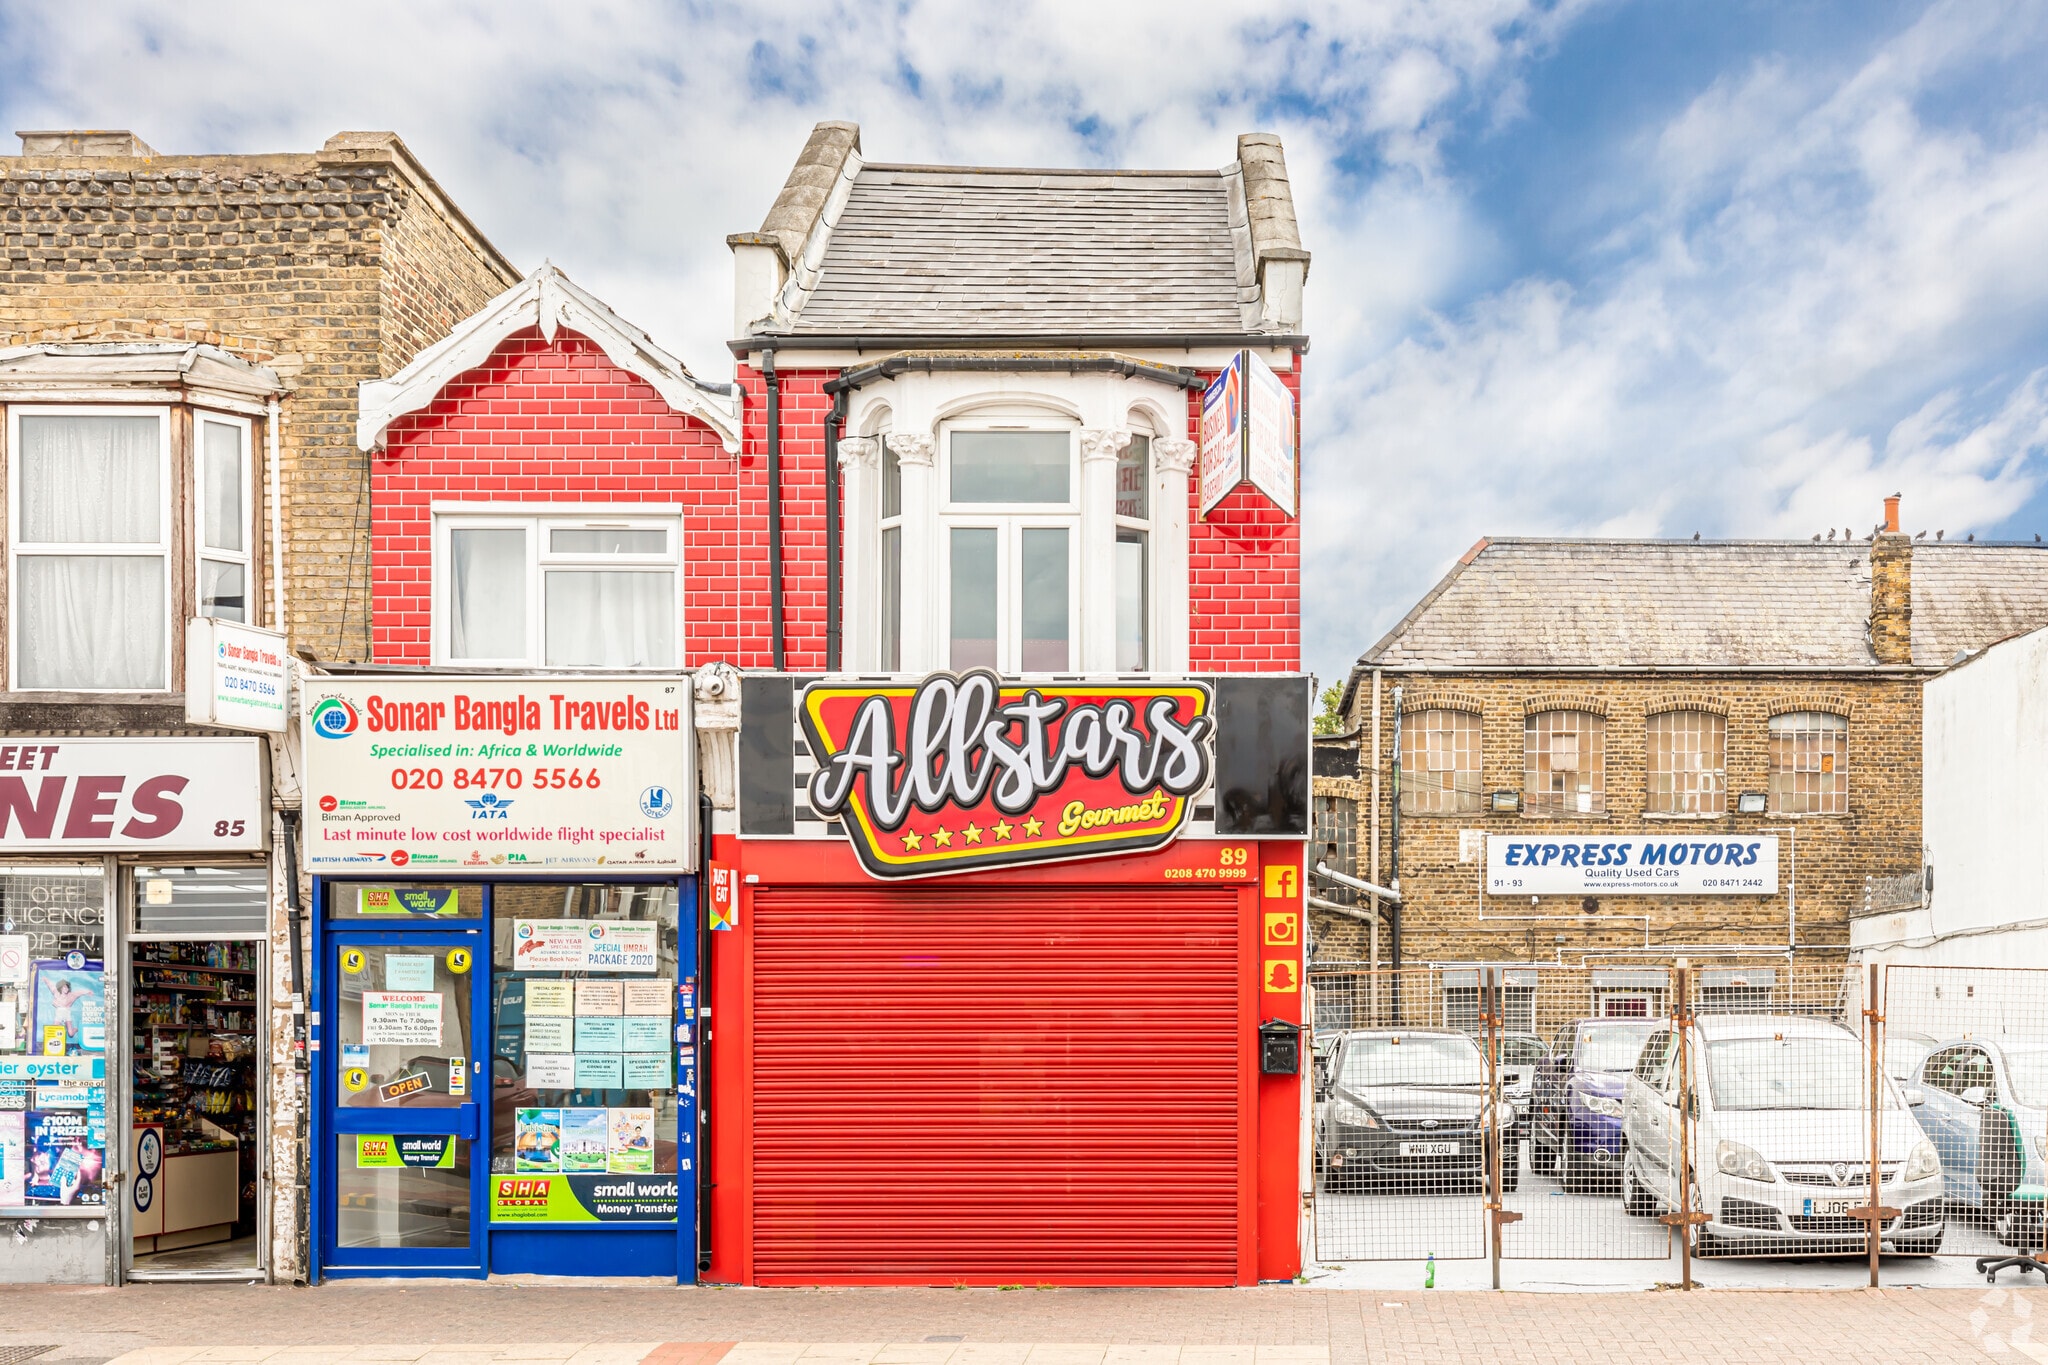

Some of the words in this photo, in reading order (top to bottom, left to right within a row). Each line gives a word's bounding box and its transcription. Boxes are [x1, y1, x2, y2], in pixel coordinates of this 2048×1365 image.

[1203, 403, 1225, 444] BUSINESS
[1203, 446, 1213, 478] FOR
[1213, 437, 1225, 466] SALE
[228, 643, 242, 658] Sonar
[243, 646, 258, 663] Bangla
[260, 649, 276, 665] Travels
[224, 676, 238, 689] 020
[240, 678, 257, 692] 8470
[259, 682, 276, 695] 5566
[367, 695, 446, 732] Sonar
[454, 695, 540, 736] Bangla
[550, 695, 649, 731] Travels
[655, 709, 679, 730] Ltd
[0, 745, 60, 771] EET
[370, 744, 452, 759] Specialised
[455, 744, 474, 757] in:
[478, 743, 521, 759] Africa
[526, 744, 538, 757] &
[543, 743, 623, 757] Worldwide
[814, 675, 1204, 825] Allstars
[391, 768, 443, 790] 020
[453, 768, 523, 790] 8470
[532, 768, 601, 790] 5566
[0, 774, 191, 839] NES
[472, 810, 508, 819] IATA
[642, 800, 672, 819] PROTECTED
[1057, 789, 1171, 836] Gourmet
[321, 813, 352, 822] Biman
[354, 813, 401, 823] Approved
[213, 819, 246, 837] 85
[323, 828, 352, 841] Last
[356, 827, 407, 841] minute
[411, 827, 438, 841] low
[442, 829, 471, 841] cost
[476, 827, 553, 841] worldwide
[558, 827, 595, 845] flight
[599, 827, 665, 845] specialist
[545, 857, 559, 865] JET
[1220, 847, 1248, 865] 89
[1505, 843, 1632, 868] EXPRESS
[1640, 843, 1761, 868] MOTORS
[713, 868, 729, 887] JUST
[1164, 868, 1192, 878] 0208
[1195, 868, 1216, 878] 470
[1219, 868, 1247, 878] 9999
[1585, 869, 1622, 879] Quality
[1625, 868, 1652, 877] Used
[1655, 868, 1680, 877] Cars
[1702, 879, 1718, 887] 020
[1720, 879, 1740, 887] 8471
[1742, 879, 1763, 887] 2442
[31, 886, 77, 903] OFF
[369, 892, 389, 901] SHA
[404, 891, 428, 900] small
[716, 886, 729, 902] EAT
[410, 898, 436, 908] world
[594, 943, 621, 953] SPECIAL
[623, 943, 648, 953] UMRAH
[588, 954, 628, 965] PACKAGE
[630, 954, 654, 965] 2020
[26, 1061, 79, 1077] oyster
[389, 1077, 423, 1096] OPEN
[39, 1093, 88, 1102] Lycamob
[42, 1116, 83, 1126] £100M
[630, 1112, 651, 1121] India
[35, 1126, 48, 1136] IN
[50, 1126, 88, 1136] PRIZES
[520, 1123, 556, 1133] Pakistan
[363, 1140, 387, 1151] SHA
[402, 1140, 421, 1151] small
[421, 1140, 442, 1151] world
[1430, 1144, 1451, 1154] XGU
[403, 1154, 419, 1162] Money
[500, 1181, 548, 1197] SHA
[593, 1181, 635, 1197] small
[597, 1203, 632, 1215] Money
[634, 1203, 678, 1214] Transfer
